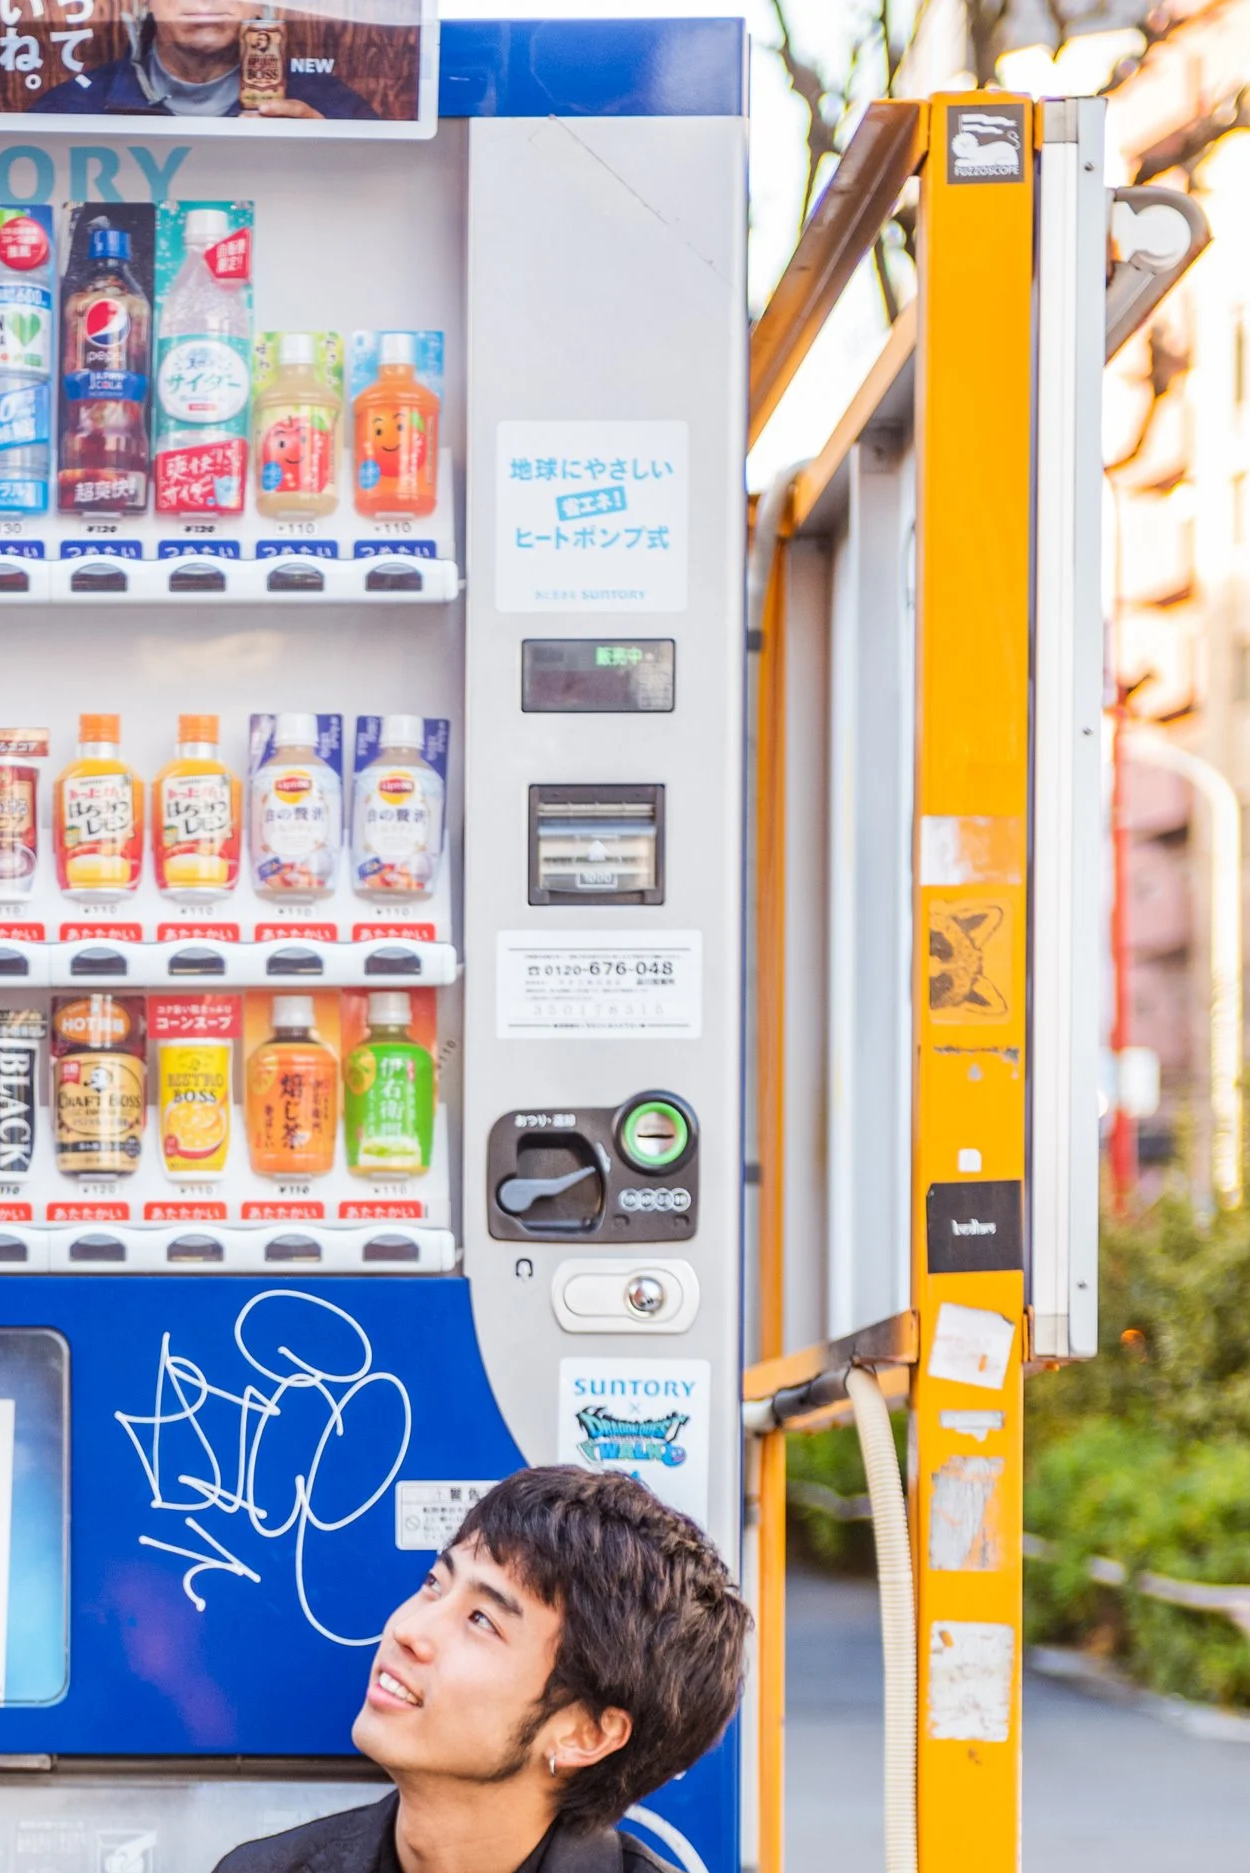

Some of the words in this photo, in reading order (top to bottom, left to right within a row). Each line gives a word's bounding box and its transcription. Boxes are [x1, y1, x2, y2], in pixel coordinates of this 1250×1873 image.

[290, 57, 335, 73] NEW
[165, 372, 241, 393] サイダー
[510, 458, 674, 481] 地球にやさしい
[561, 490, 623, 518] 省エネ!
[516, 524, 670, 550] ヒートポンプ式
[544, 962, 674, 976] 0120-676-048
[155, 1015, 234, 1031] コーンスープ
[58, 1091, 101, 1108] CRAFT
[108, 1093, 142, 1108] BOSS
[173, 1089, 218, 1103] BOSS
[54, 1208, 123, 1221] あたたかい
[151, 1208, 220, 1220] あたたかい
[249, 1206, 318, 1219] あたたかい
[346, 1206, 415, 1219] あたたかい
[573, 1378, 696, 1397] SUNTORY
[598, 1442, 664, 1461] WALK
